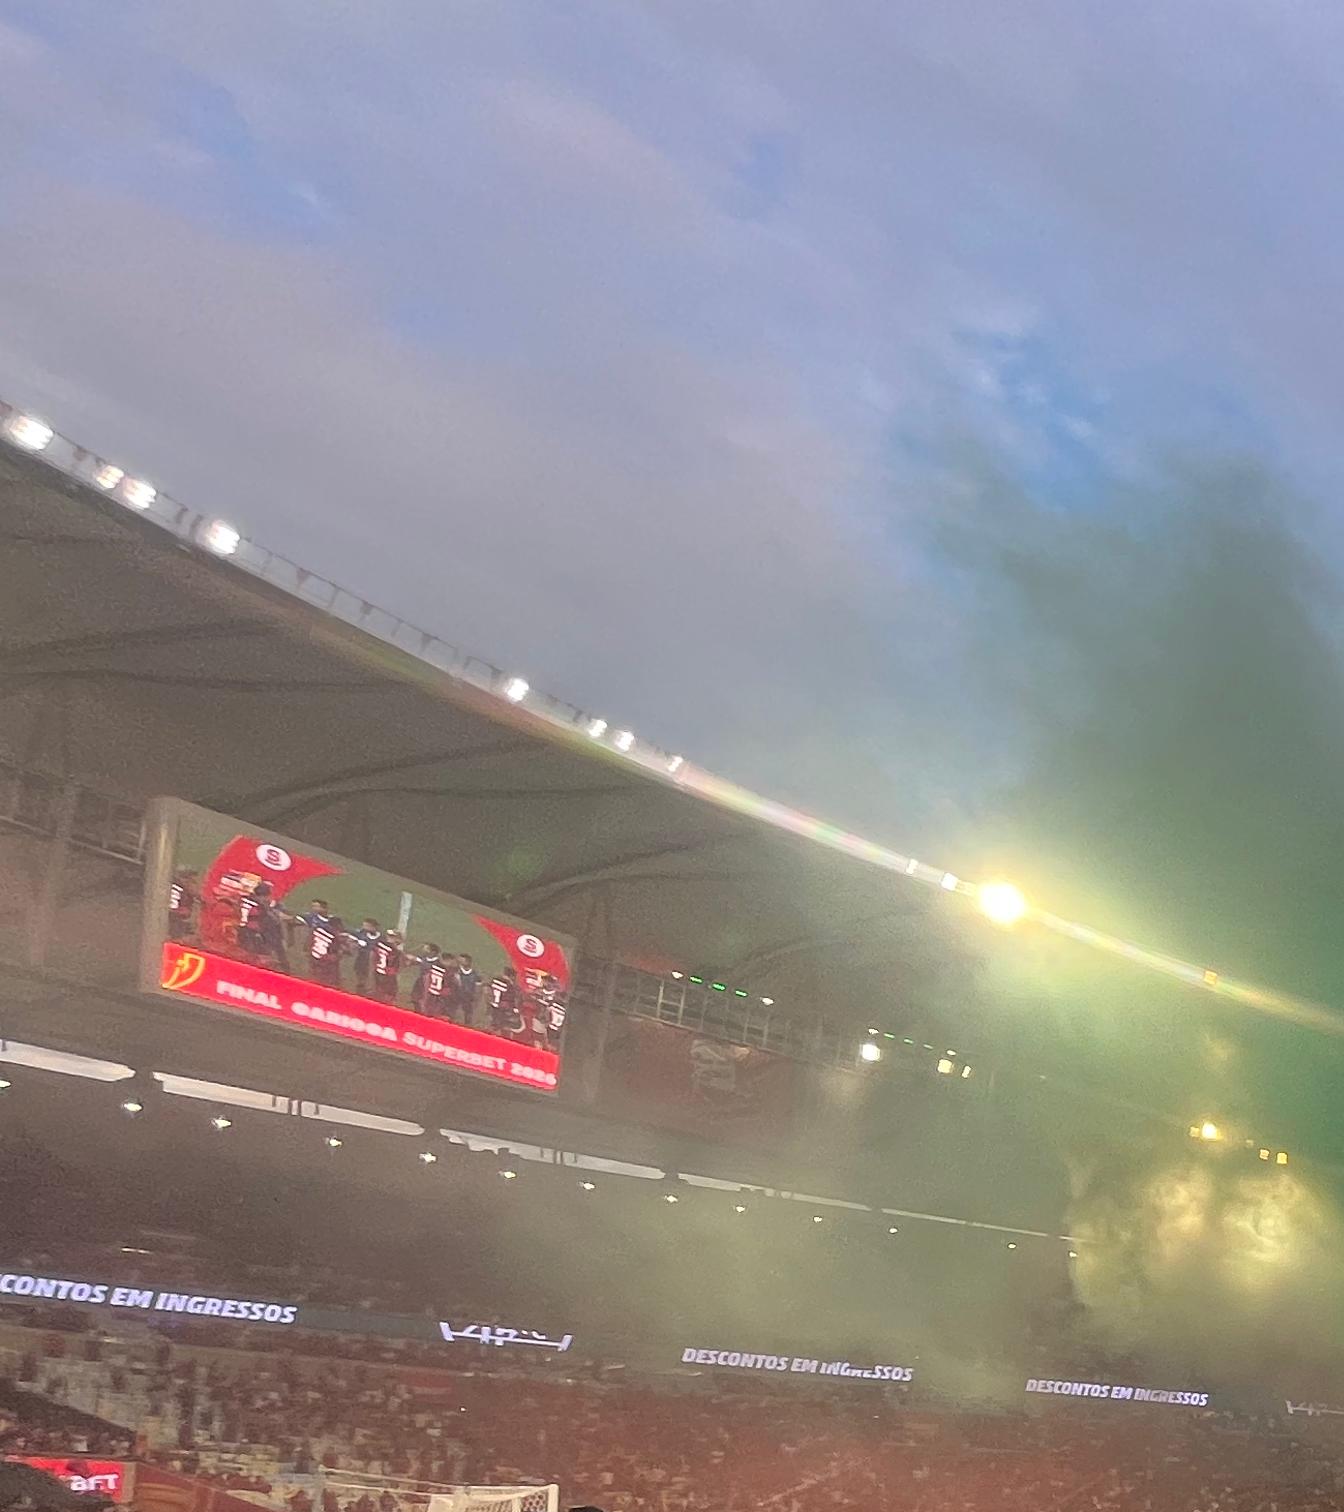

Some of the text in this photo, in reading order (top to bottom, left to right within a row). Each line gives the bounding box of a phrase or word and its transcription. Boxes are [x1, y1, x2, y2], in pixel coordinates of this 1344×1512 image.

[216, 980, 282, 1010] FINAL
[402, 1031, 507, 1070] SUPERBET
[511, 1062, 557, 1086] 2026
[0, 1274, 298, 1323] CONTOS EM INGRESSOS
[681, 1348, 789, 1371] DESCONTOS
[791, 1358, 818, 1374] EM
[1026, 1379, 1209, 1407] DESCONTOS EM INGRESSOS
